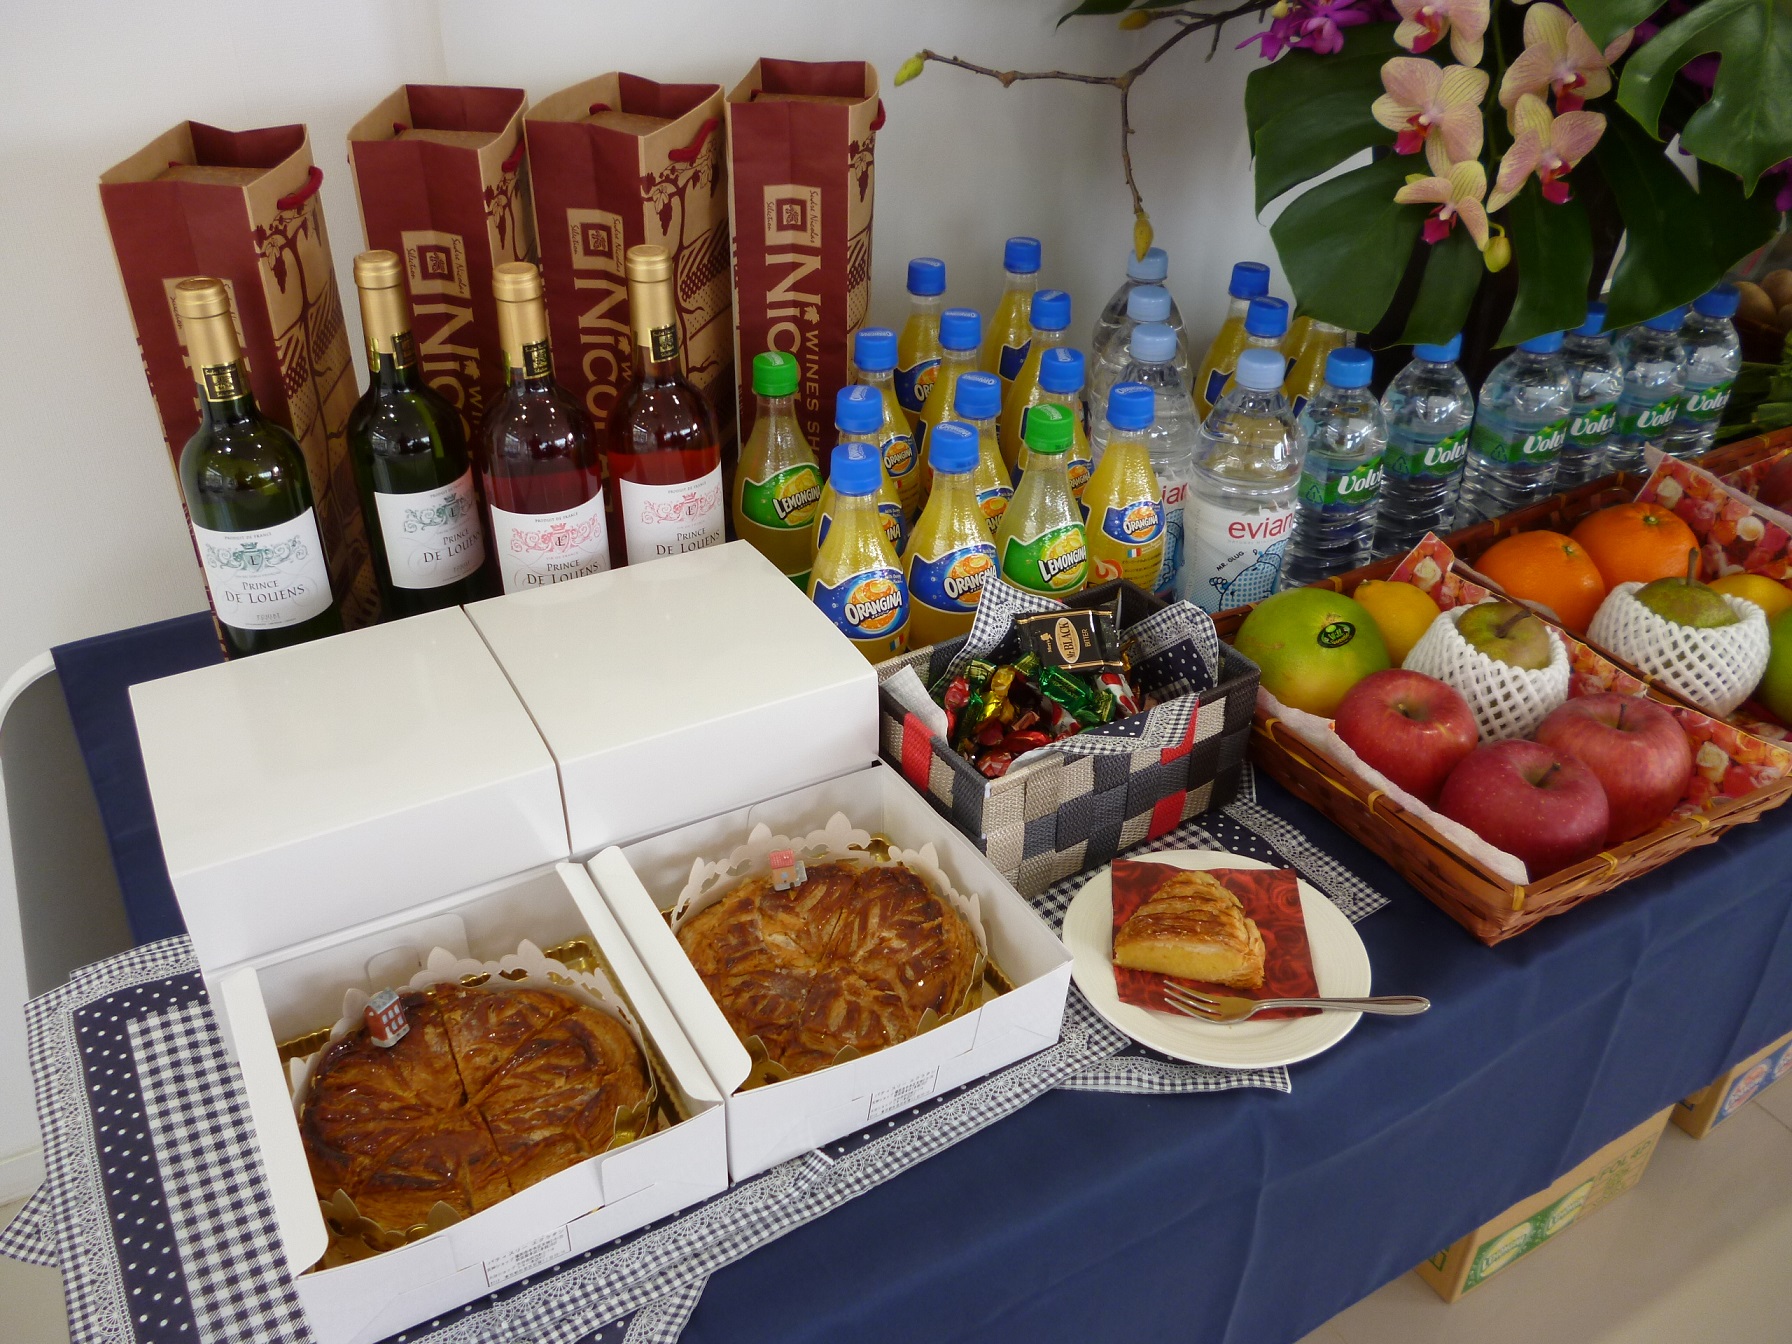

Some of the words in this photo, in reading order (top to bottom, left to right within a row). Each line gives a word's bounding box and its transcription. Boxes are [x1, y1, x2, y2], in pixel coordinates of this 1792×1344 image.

[805, 330, 819, 412] WINES
[807, 421, 820, 452] SH
[676, 527, 706, 542] PRINCE
[1122, 514, 1159, 535] ORANGINA
[1228, 512, 1293, 540] evian
[656, 544, 675, 555] DE
[680, 529, 720, 553] LOUENS
[423, 551, 442, 563] DE
[547, 559, 581, 572] PRINCE
[1216, 561, 1228, 572] MR.
[242, 580, 279, 591] PRINCE
[527, 573, 545, 587] DE
[225, 590, 243, 604] DE
[249, 584, 305, 604] LOUENS
[844, 590, 903, 625] ORANGINA
